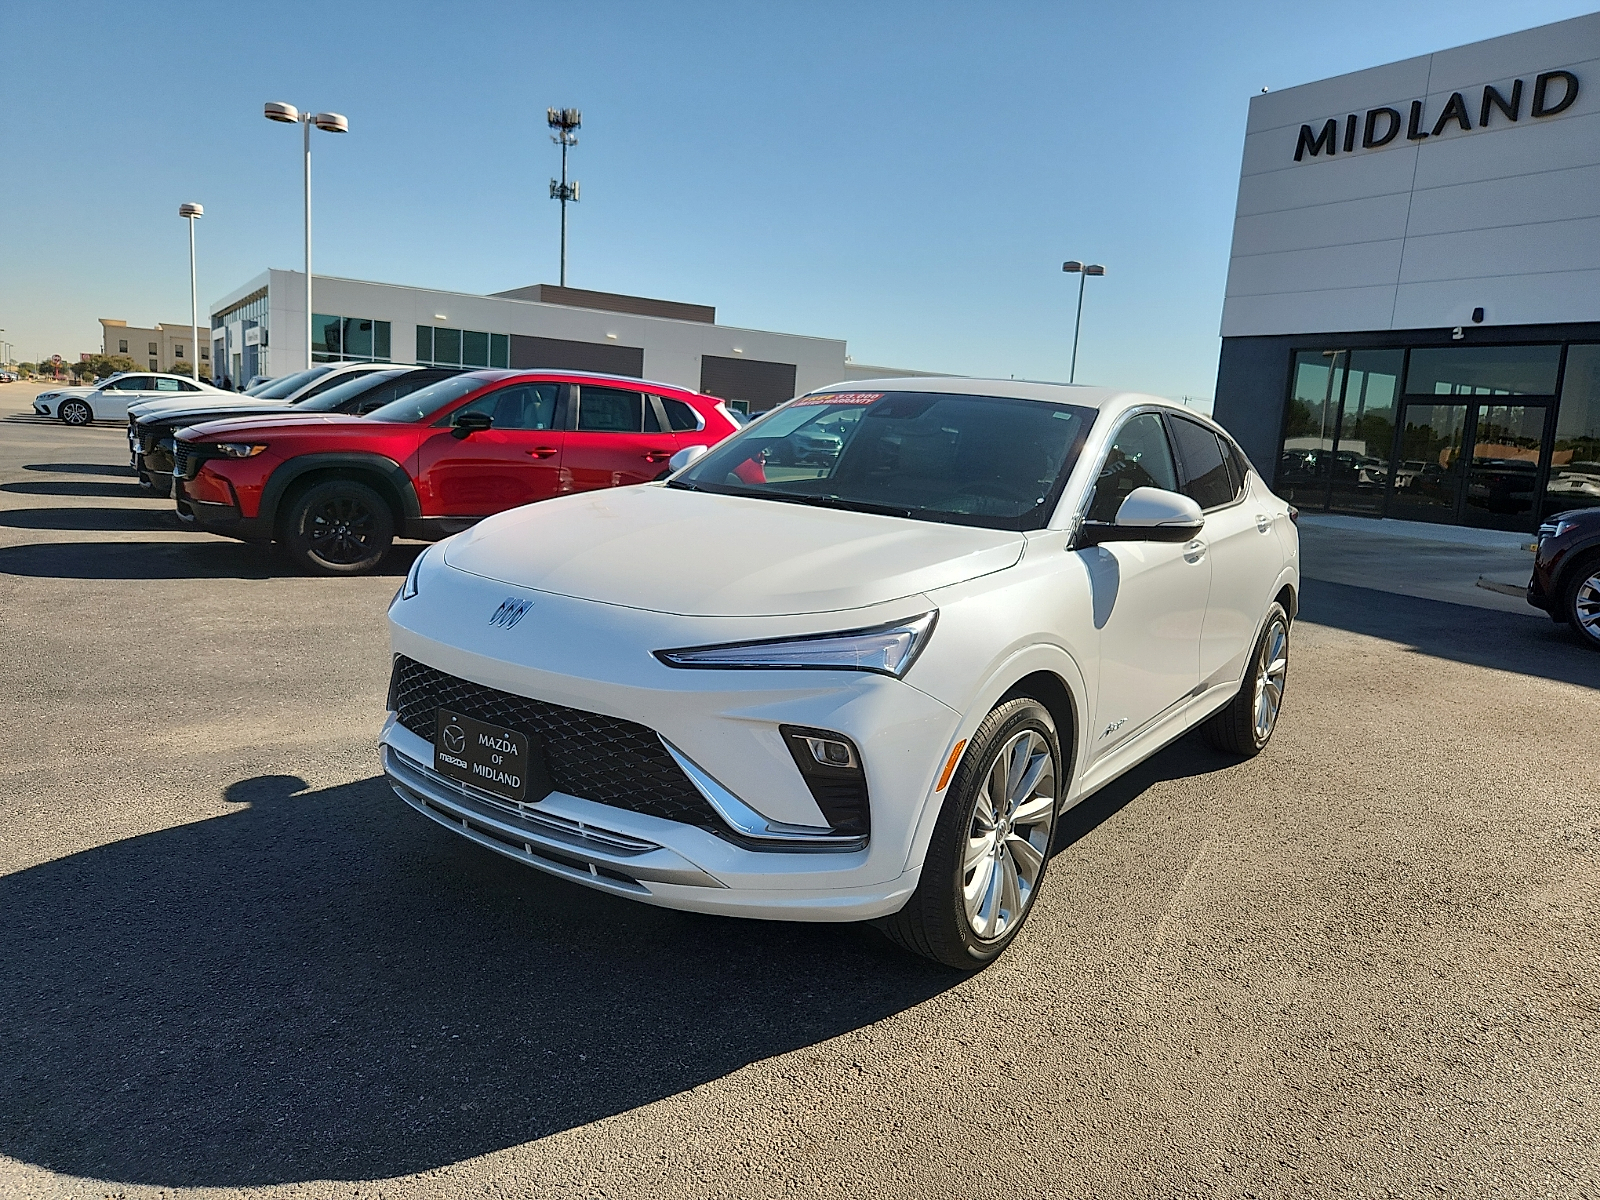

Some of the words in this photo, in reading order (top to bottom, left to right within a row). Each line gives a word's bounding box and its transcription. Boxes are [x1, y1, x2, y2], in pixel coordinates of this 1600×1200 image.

[1293, 70, 1579, 162] MIDLAND
[478, 733, 519, 756] MAZDA
[439, 752, 468, 769] mazda
[491, 753, 504, 765] OF
[472, 762, 521, 788] MIDLAND
